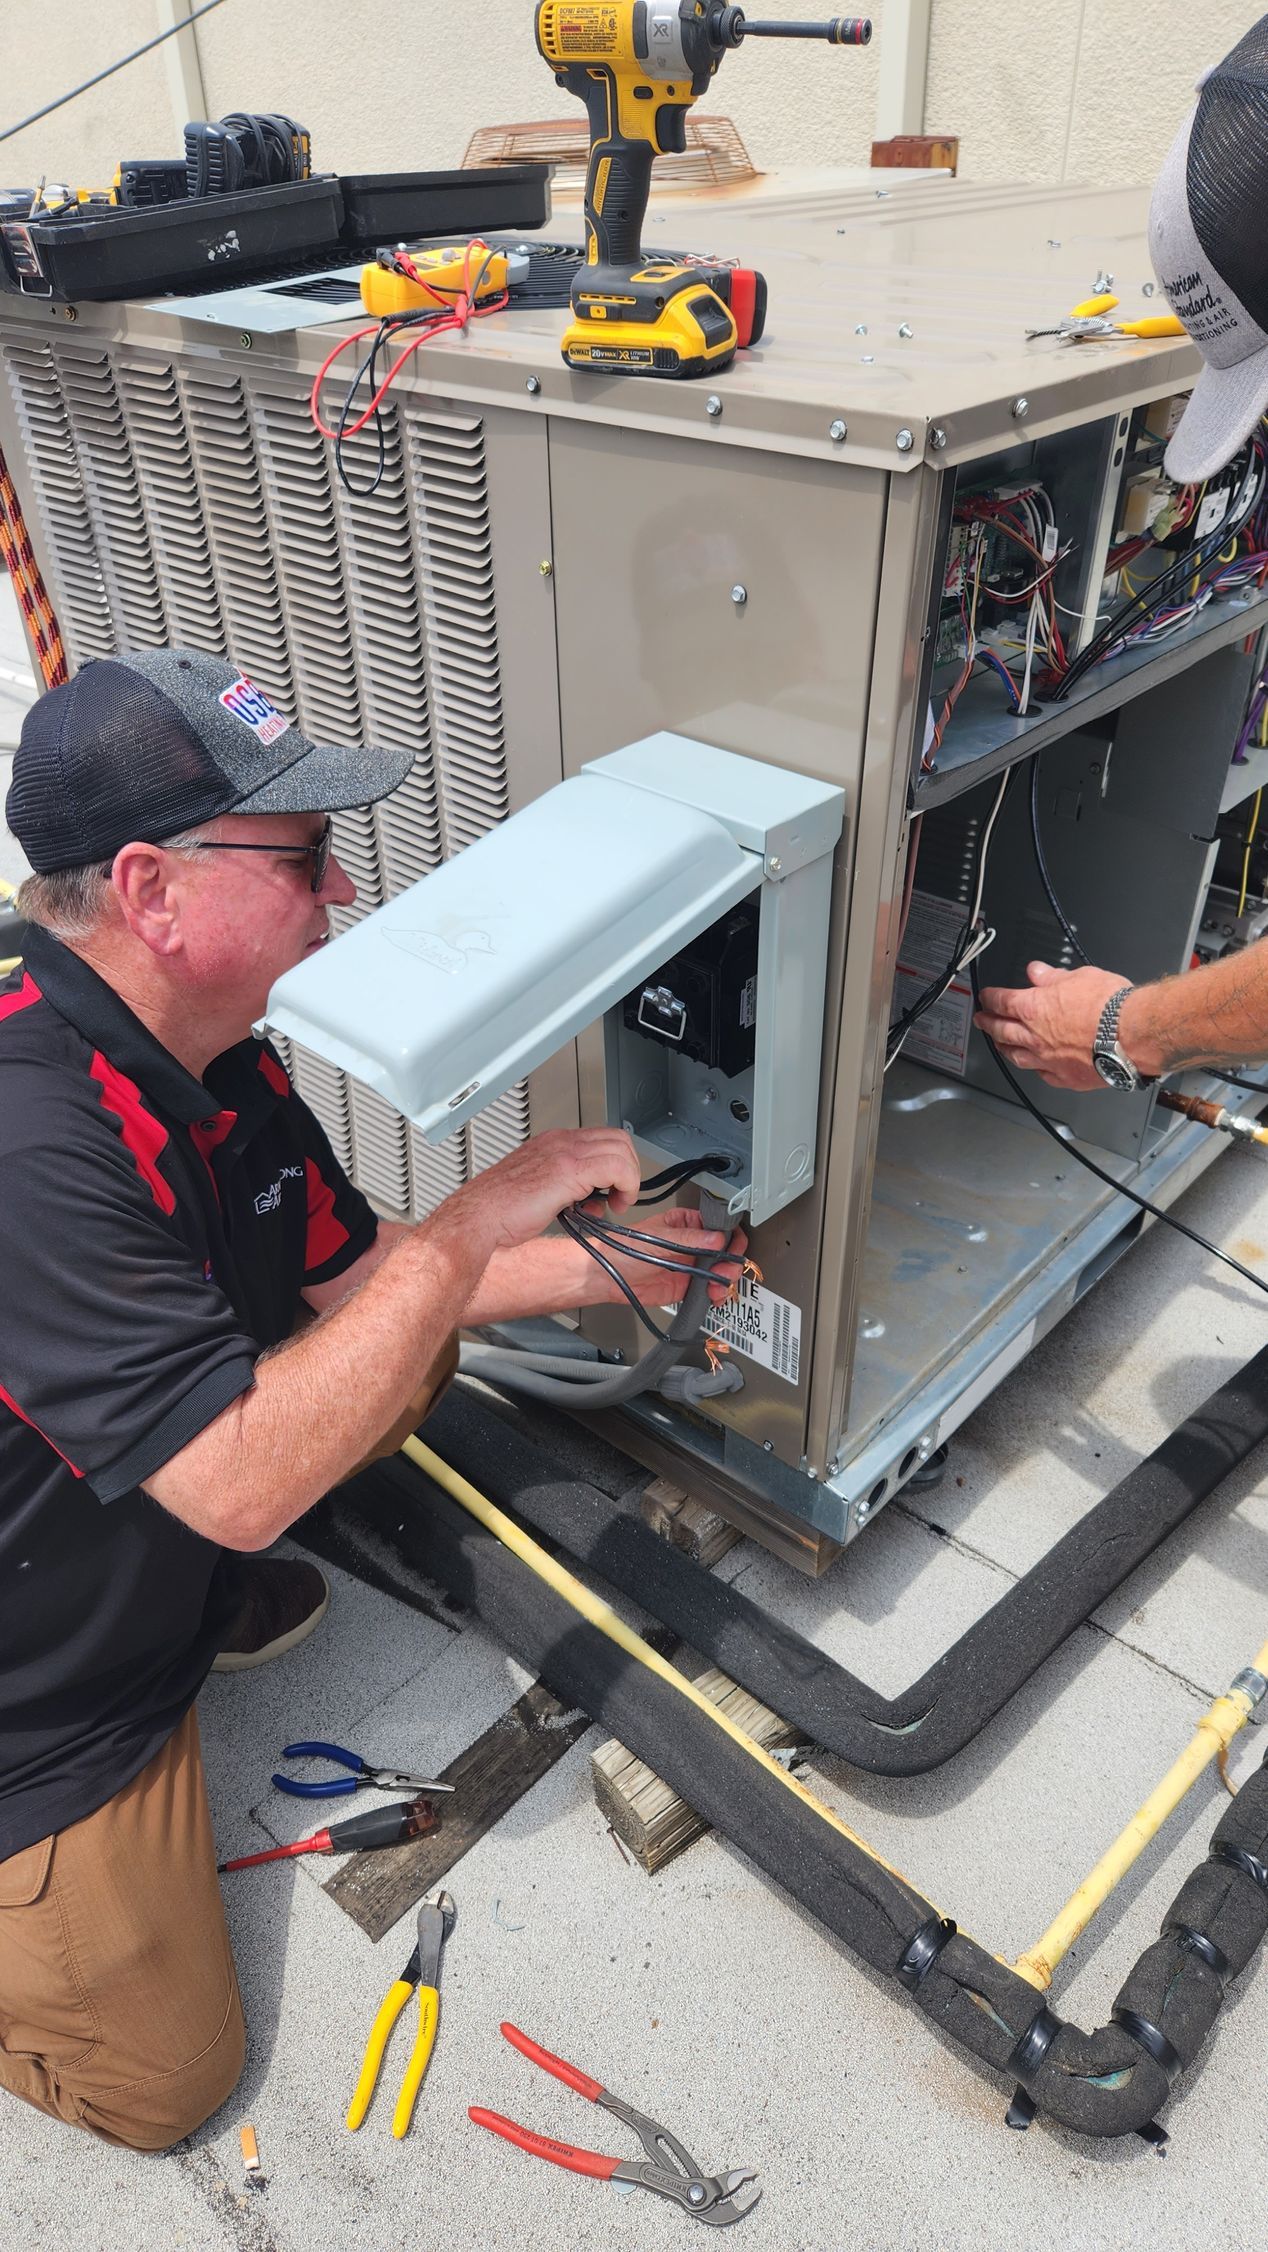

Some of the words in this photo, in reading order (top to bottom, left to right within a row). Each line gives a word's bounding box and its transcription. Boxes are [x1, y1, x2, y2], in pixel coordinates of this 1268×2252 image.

[652, 23, 670, 38] XR
[1171, 284, 1216, 318] tandard
[1206, 316, 1213, 325] &
[1213, 308, 1231, 322] AIR
[618, 350, 631, 360] XR
[257, 715, 287, 742] HEATIN
